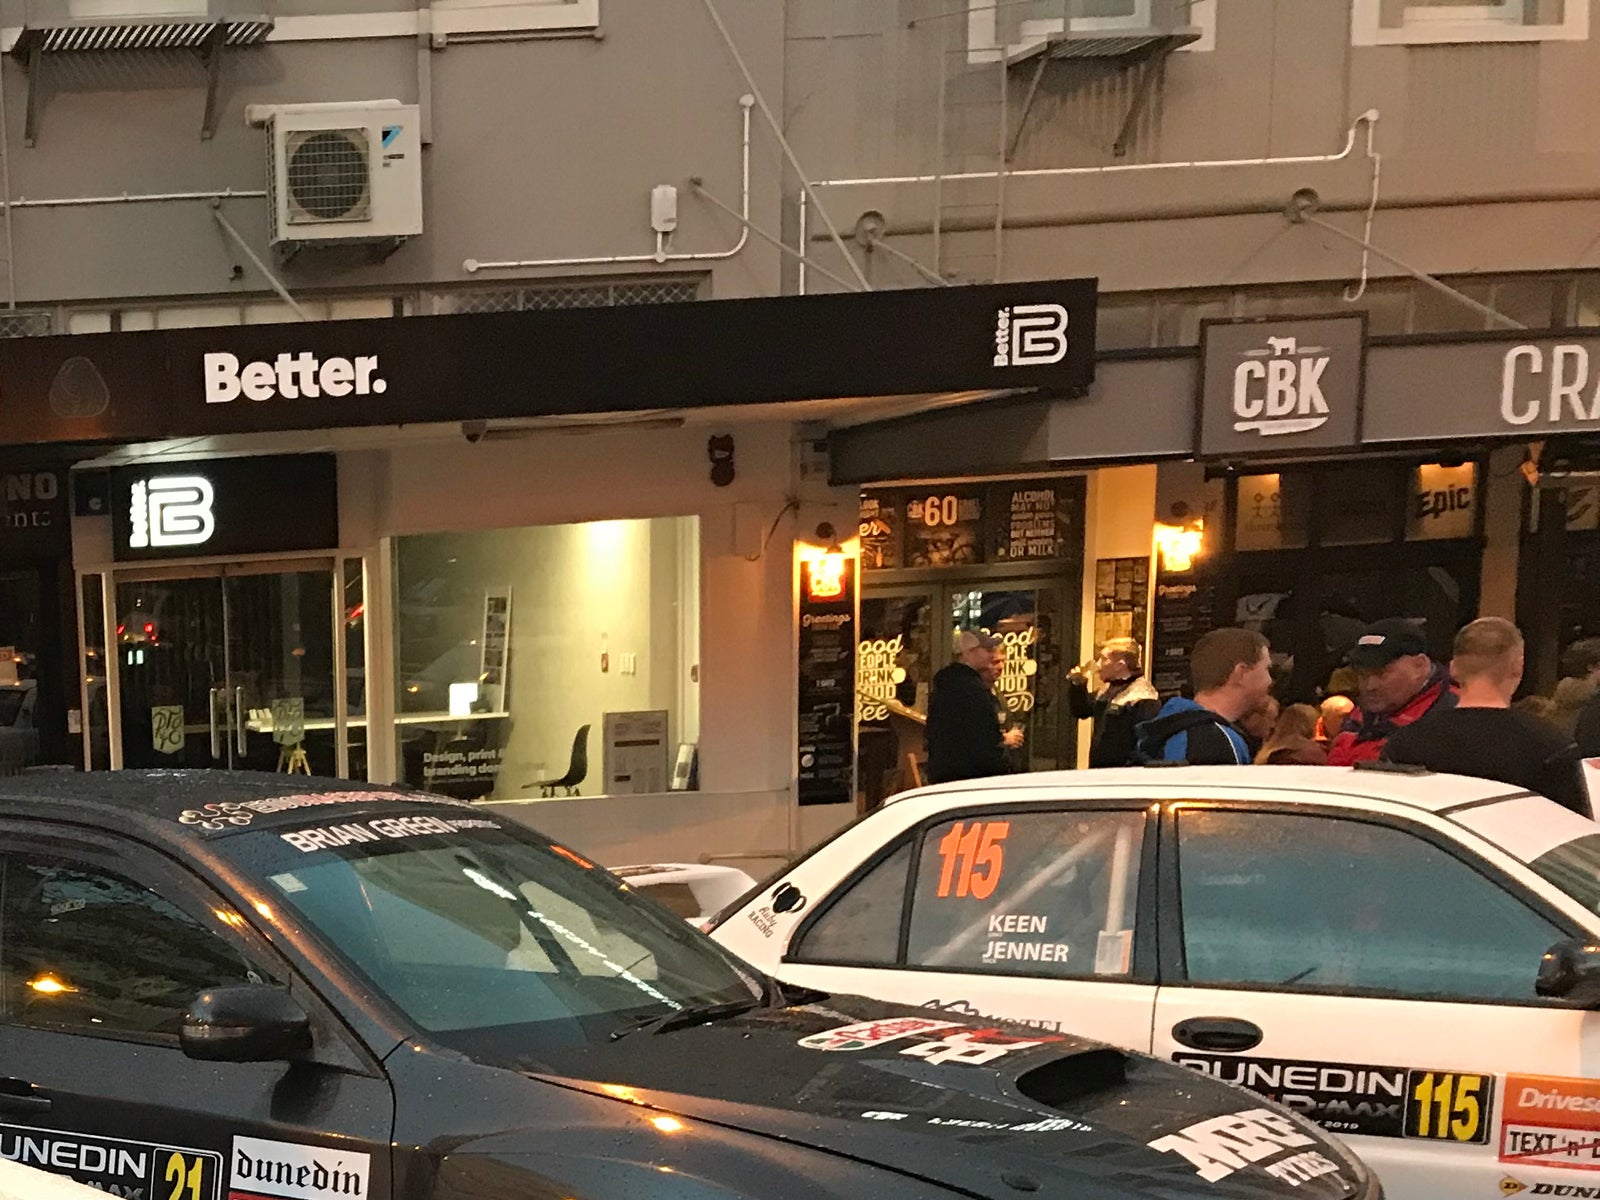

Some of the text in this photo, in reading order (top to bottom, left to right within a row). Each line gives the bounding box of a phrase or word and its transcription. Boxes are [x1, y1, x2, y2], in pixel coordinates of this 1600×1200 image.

[203, 351, 388, 404] Better.
[1233, 356, 1331, 419] CBK
[924, 495, 958, 526] 60
[1415, 483, 1471, 520] Epic
[467, 749, 497, 764] print
[280, 822, 381, 853] BRIAN
[368, 816, 458, 839] GREEN
[936, 820, 1010, 900] 115
[747, 910, 774, 938] RACING
[988, 914, 1048, 933] KEEN
[982, 940, 1069, 963] JENNER
[1323, 1119, 1360, 1131] 2019
[1413, 1072, 1483, 1142] 115
[1147, 1107, 1318, 1183] MRF
[1509, 1130, 1557, 1152] TEXT
[236, 1147, 363, 1196] dunedin
